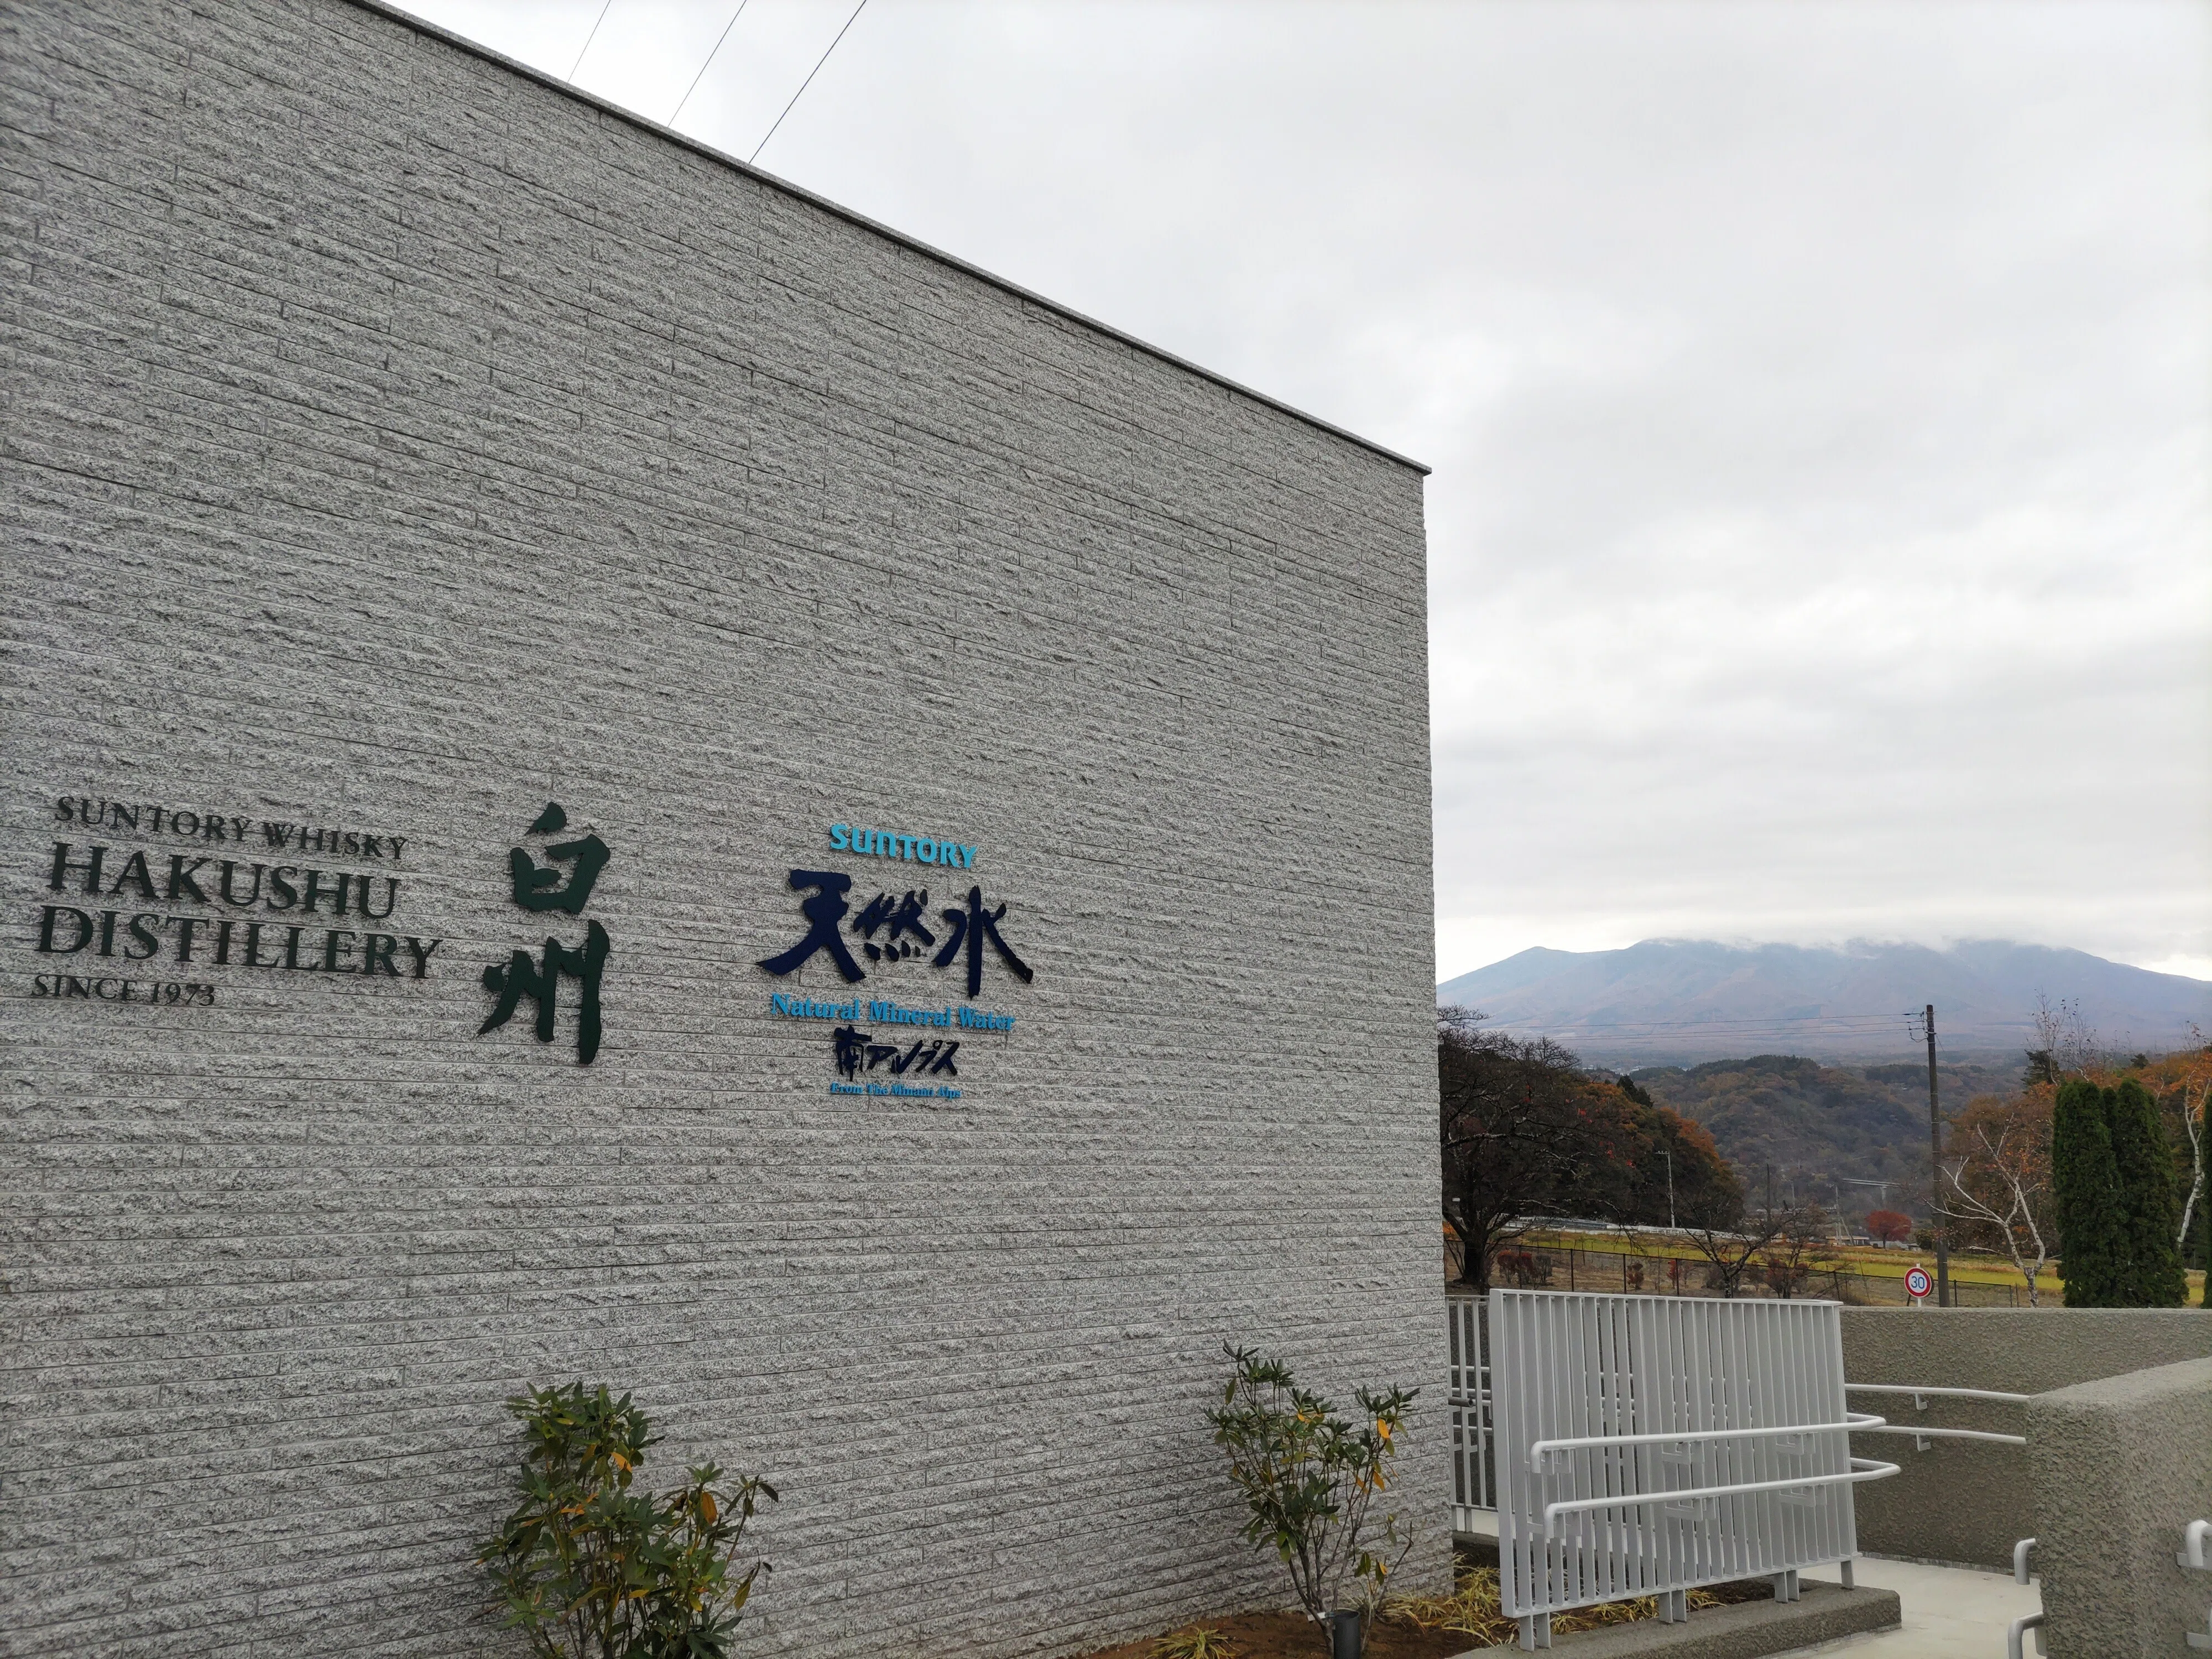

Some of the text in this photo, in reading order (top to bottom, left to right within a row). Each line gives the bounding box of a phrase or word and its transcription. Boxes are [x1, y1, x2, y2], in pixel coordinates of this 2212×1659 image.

[55, 796, 408, 860] SUNTORY WHISKY
[830, 823, 977, 868] SUNTORY
[45, 841, 401, 919] HAKUSHU
[35, 905, 442, 979] DISTILLERY
[477, 801, 611, 1065] 白州
[755, 868, 1034, 1000] 天然水
[31, 974, 215, 1006] SINCE 1973
[771, 993, 1016, 1031] Natural Mineral Water
[833, 1025, 960, 1082] 南アルプス
[831, 1081, 962, 1100] From The Minami Alps
[1911, 1276, 1925, 1289] 30
